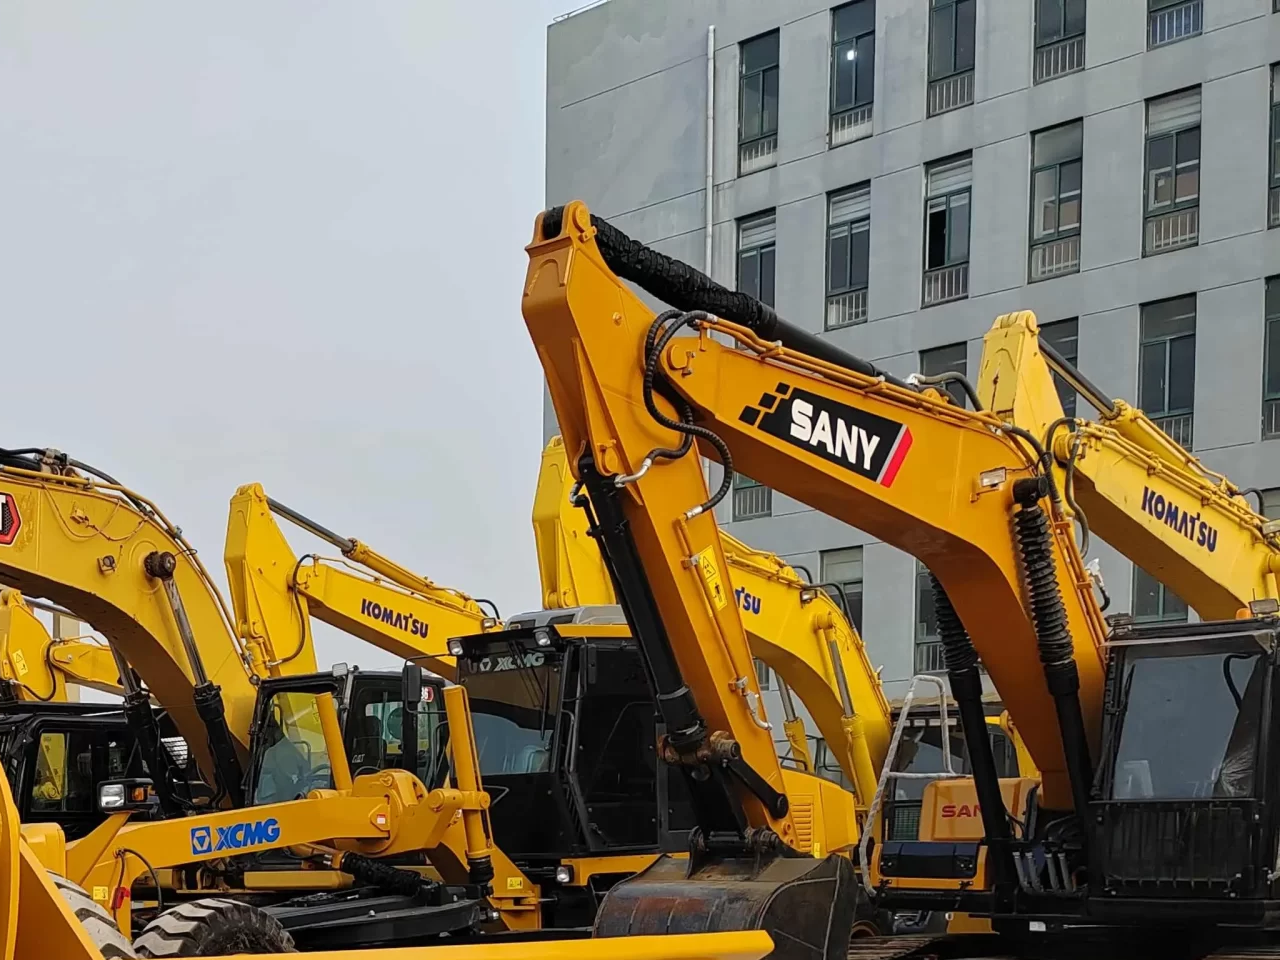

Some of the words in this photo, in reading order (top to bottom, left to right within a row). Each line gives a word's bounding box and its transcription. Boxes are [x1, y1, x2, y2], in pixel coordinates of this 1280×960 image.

[790, 398, 880, 470] SANY
[1141, 486, 1217, 552] KOMATSU
[361, 598, 428, 638] KOMATSU
[214, 818, 280, 852] XCMG
